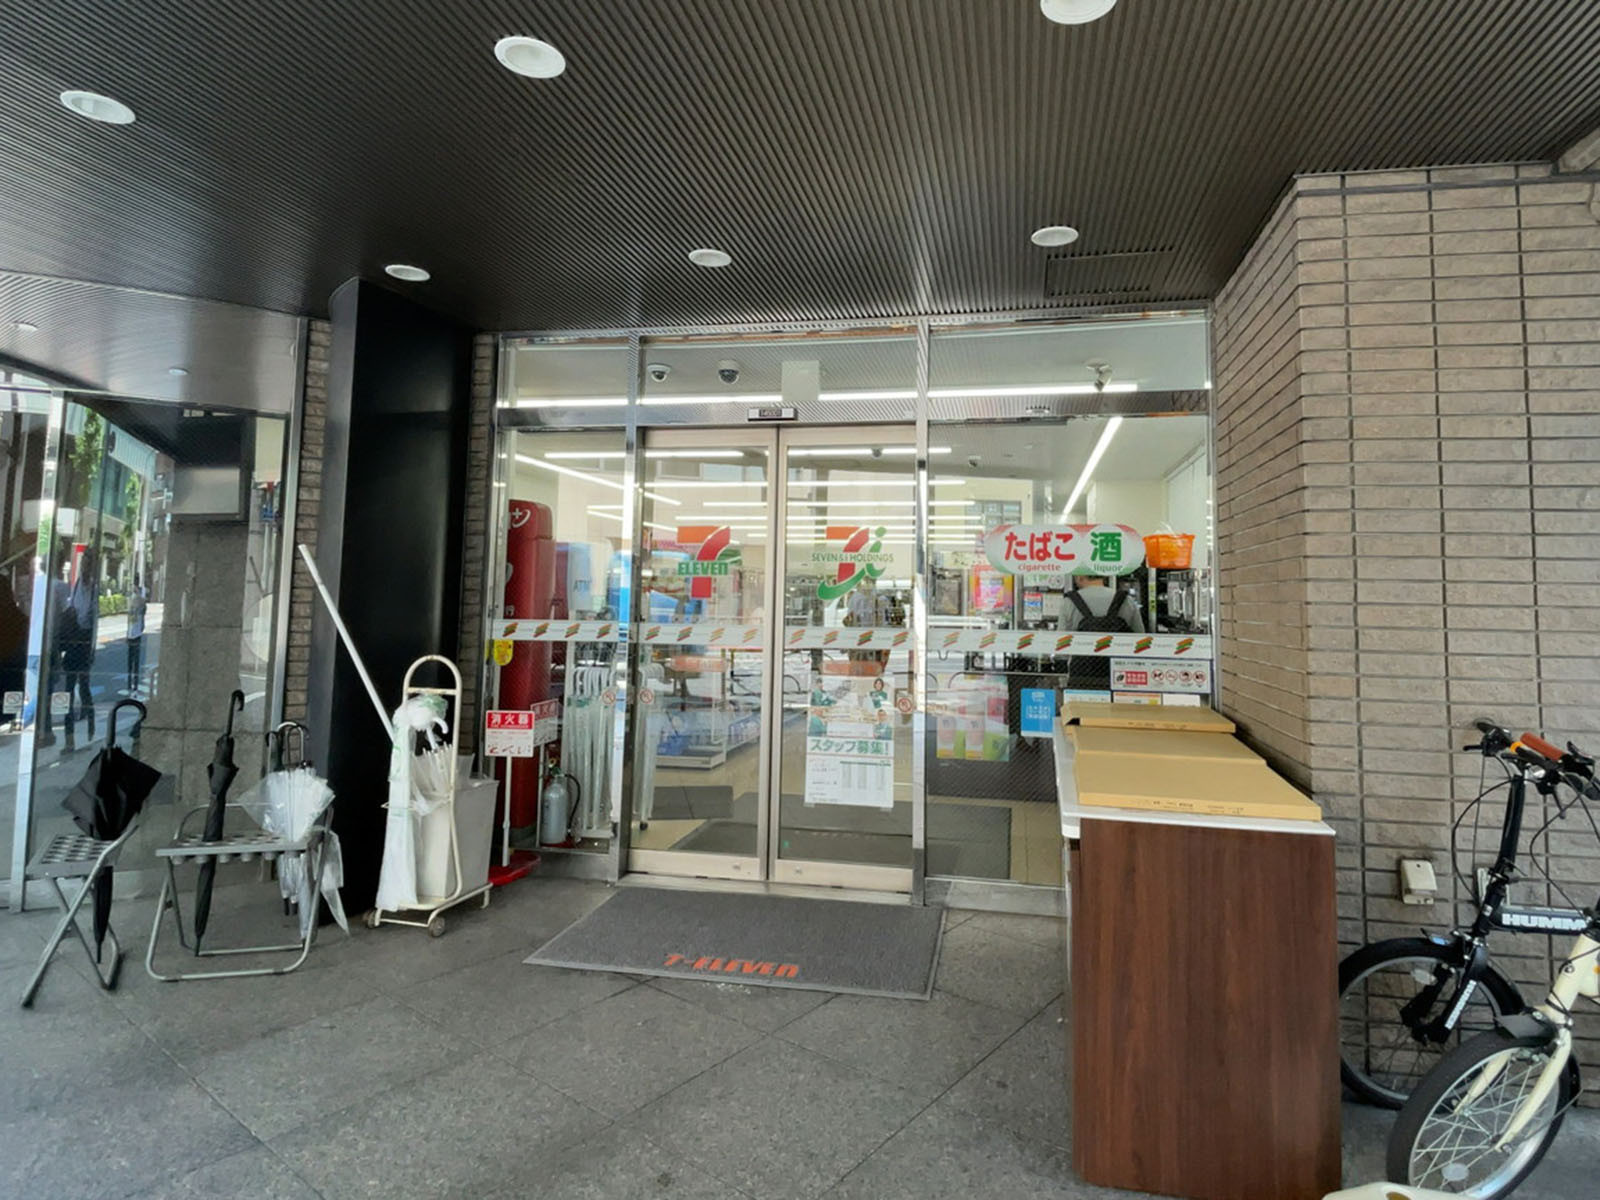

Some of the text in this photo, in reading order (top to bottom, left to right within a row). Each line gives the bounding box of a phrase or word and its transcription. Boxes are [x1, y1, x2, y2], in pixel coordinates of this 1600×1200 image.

[1004, 531, 1123, 562] たばこ 酒
[849, 553, 894, 562] HOLDINGS
[1018, 562, 1123, 573] cigarette liquor
[490, 713, 529, 725] 消火器
[1501, 913, 1588, 931] HUMM
